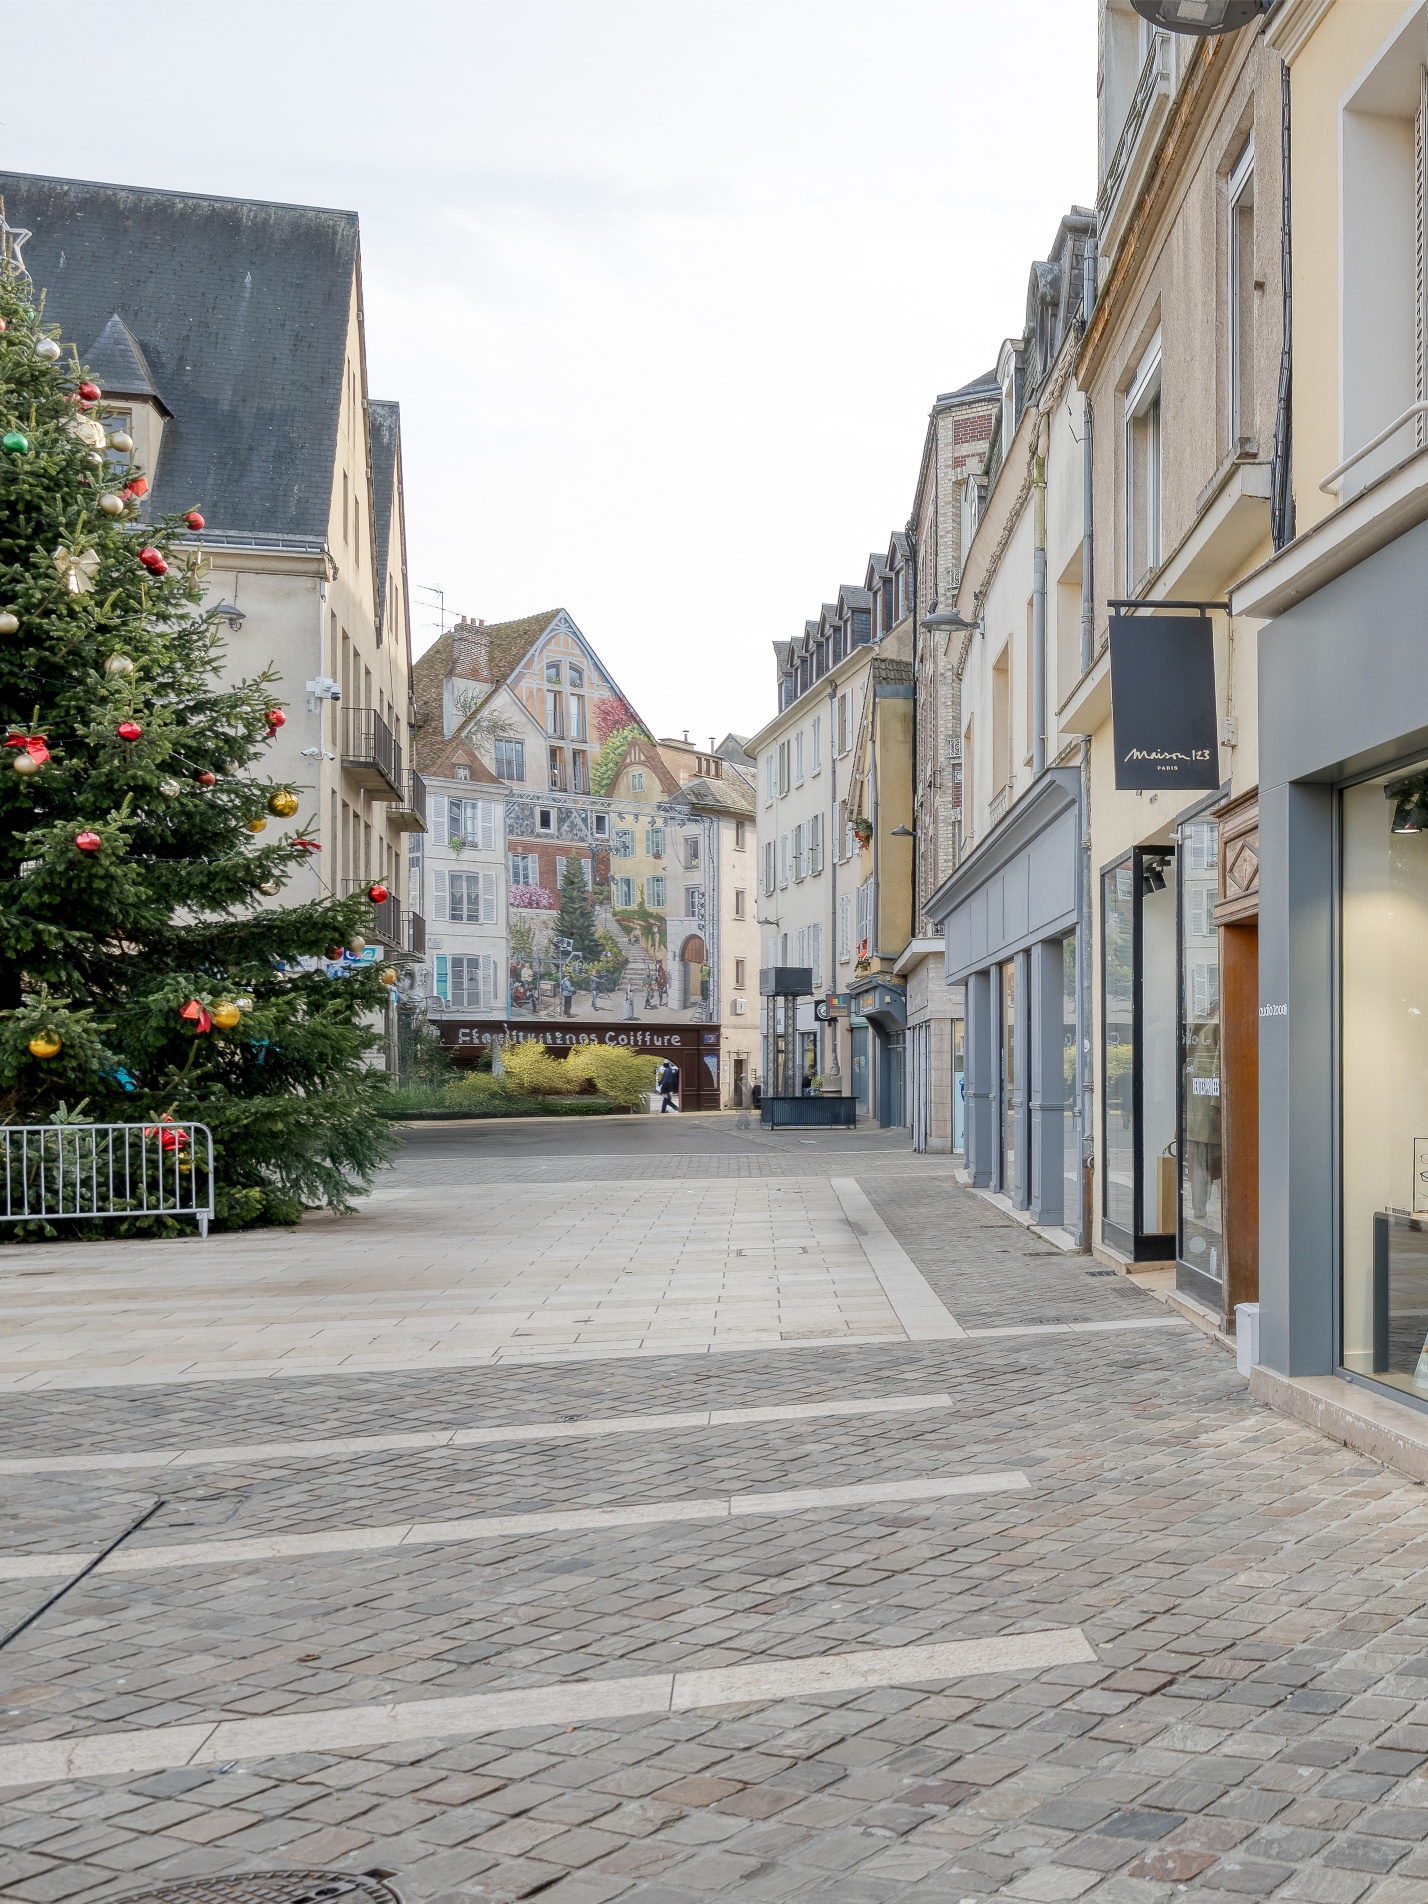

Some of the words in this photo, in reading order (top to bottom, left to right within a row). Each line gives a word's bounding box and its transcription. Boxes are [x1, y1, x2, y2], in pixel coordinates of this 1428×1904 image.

[1124, 748, 1191, 762] Maison
[1191, 749, 1210, 760] 123
[605, 1031, 682, 1046] Coiffure
